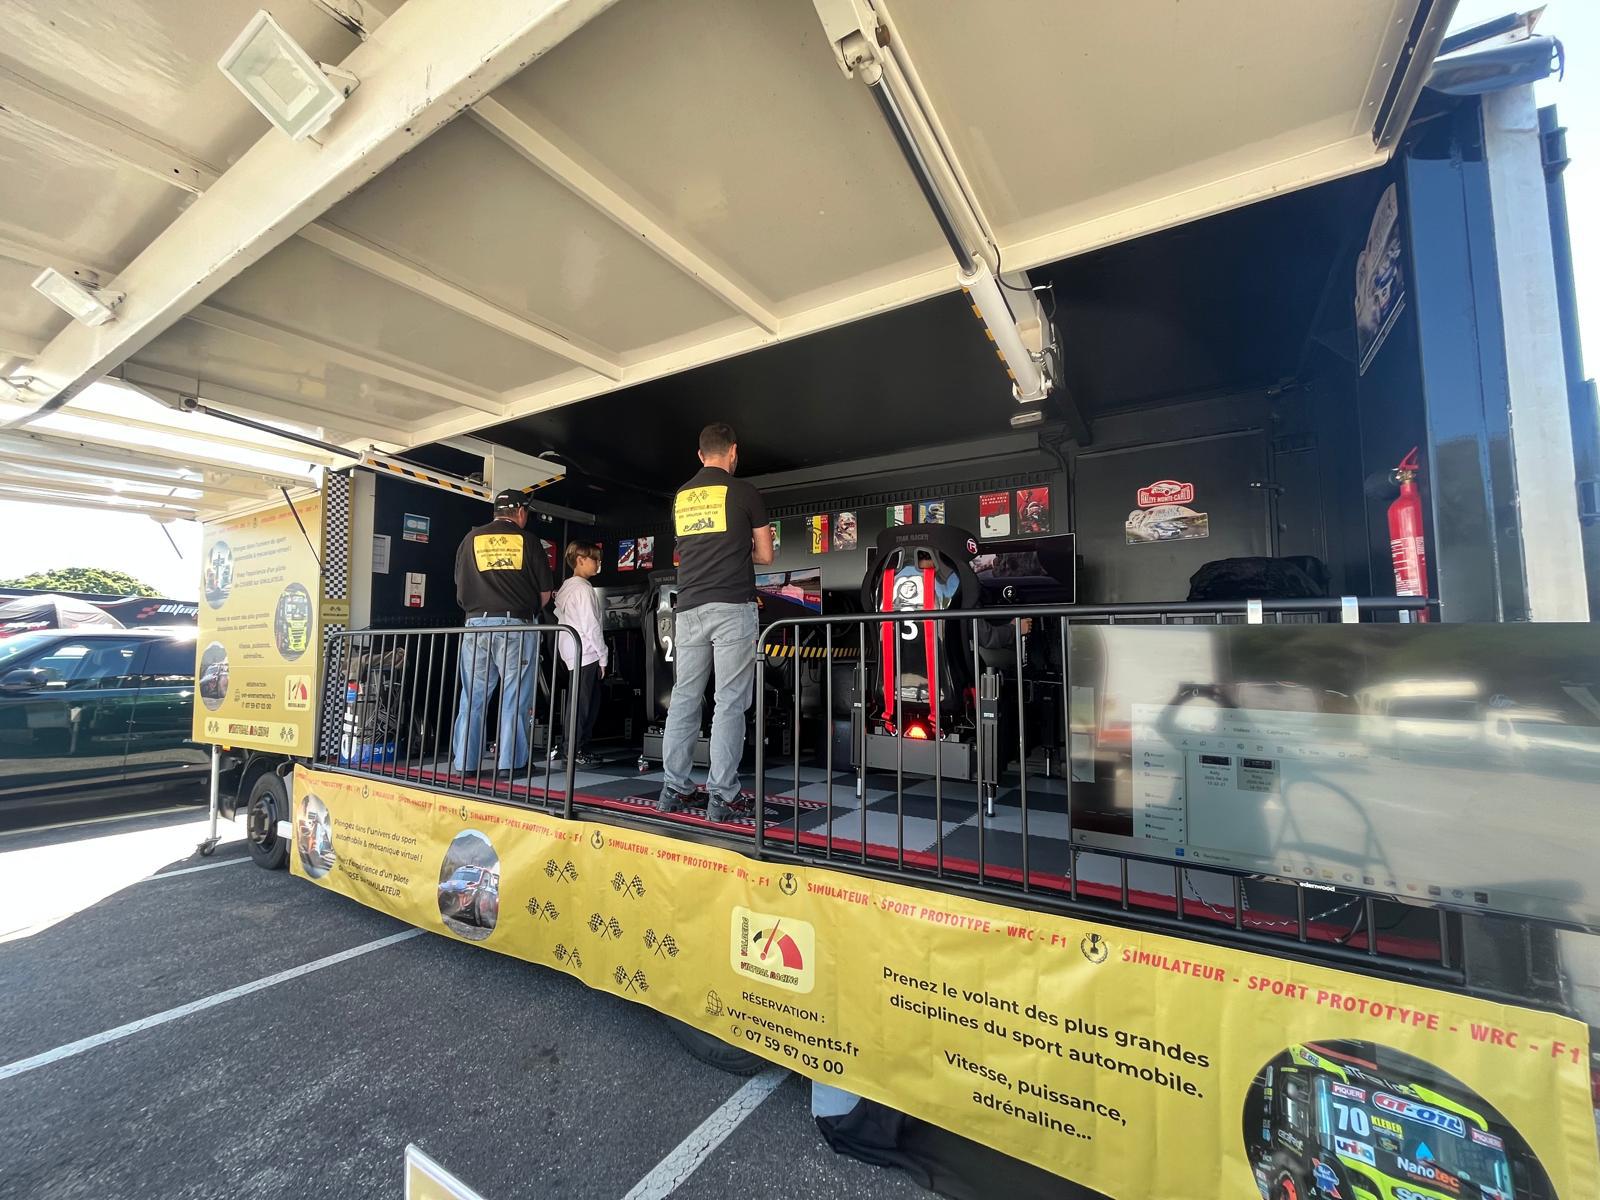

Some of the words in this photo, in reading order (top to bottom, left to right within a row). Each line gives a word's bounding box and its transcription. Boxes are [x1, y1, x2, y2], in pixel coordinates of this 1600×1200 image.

[392, 833, 400, 841] du
[402, 836, 417, 846] sport
[400, 848, 420, 862] virtuel
[608, 838, 649, 856] SIMULATEUR
[656, 850, 681, 863] SPORT
[683, 856, 728, 874] PROTOTYPE
[759, 876, 770, 887] F1
[380, 869, 392, 880] d'un
[807, 882, 870, 906] SIMULATEUR
[881, 898, 917, 917] SPORT
[920, 906, 991, 934] PROTOTYPE
[1007, 926, 1034, 941] WRC
[1051, 934, 1067, 948] F1
[770, 971, 799, 986] RACING
[742, 991, 818, 1022] RÉSERVATION
[883, 966, 938, 994] Prenez
[943, 982, 958, 999] le
[962, 989, 1020, 1015] volant
[1024, 1005, 1058, 1027] des
[1064, 1018, 1109, 1042] plus
[1115, 1029, 1210, 1068] grandes
[1122, 948, 1225, 982] SIMULATEUR
[1248, 976, 1309, 999] SPORT
[1316, 990, 1440, 1031] PROTOTYPE
[1470, 1024, 1518, 1050] WRC
[1552, 1040, 1581, 1064] F1
[727, 1006, 860, 1057] vvr-evenements.fr
[746, 1029, 762, 1044] 07
[765, 1036, 780, 1052] 59
[784, 1044, 799, 1060] 67
[802, 1052, 820, 1070] 03
[823, 1060, 844, 1076] 00
[890, 994, 979, 1030] disciplines
[984, 1020, 1007, 1038] du
[1012, 1030, 1063, 1057] sport
[1069, 1046, 1204, 1099] automobile.
[944, 1050, 1013, 1090] Vitesse,
[1018, 1076, 1128, 1127] puissance,
[972, 1090, 1092, 1140] adrénaline...
[1332, 1102, 1370, 1137] 70
[1371, 1115, 1403, 1134] KLEBER
[1396, 1156, 1460, 1188] Nanotec
